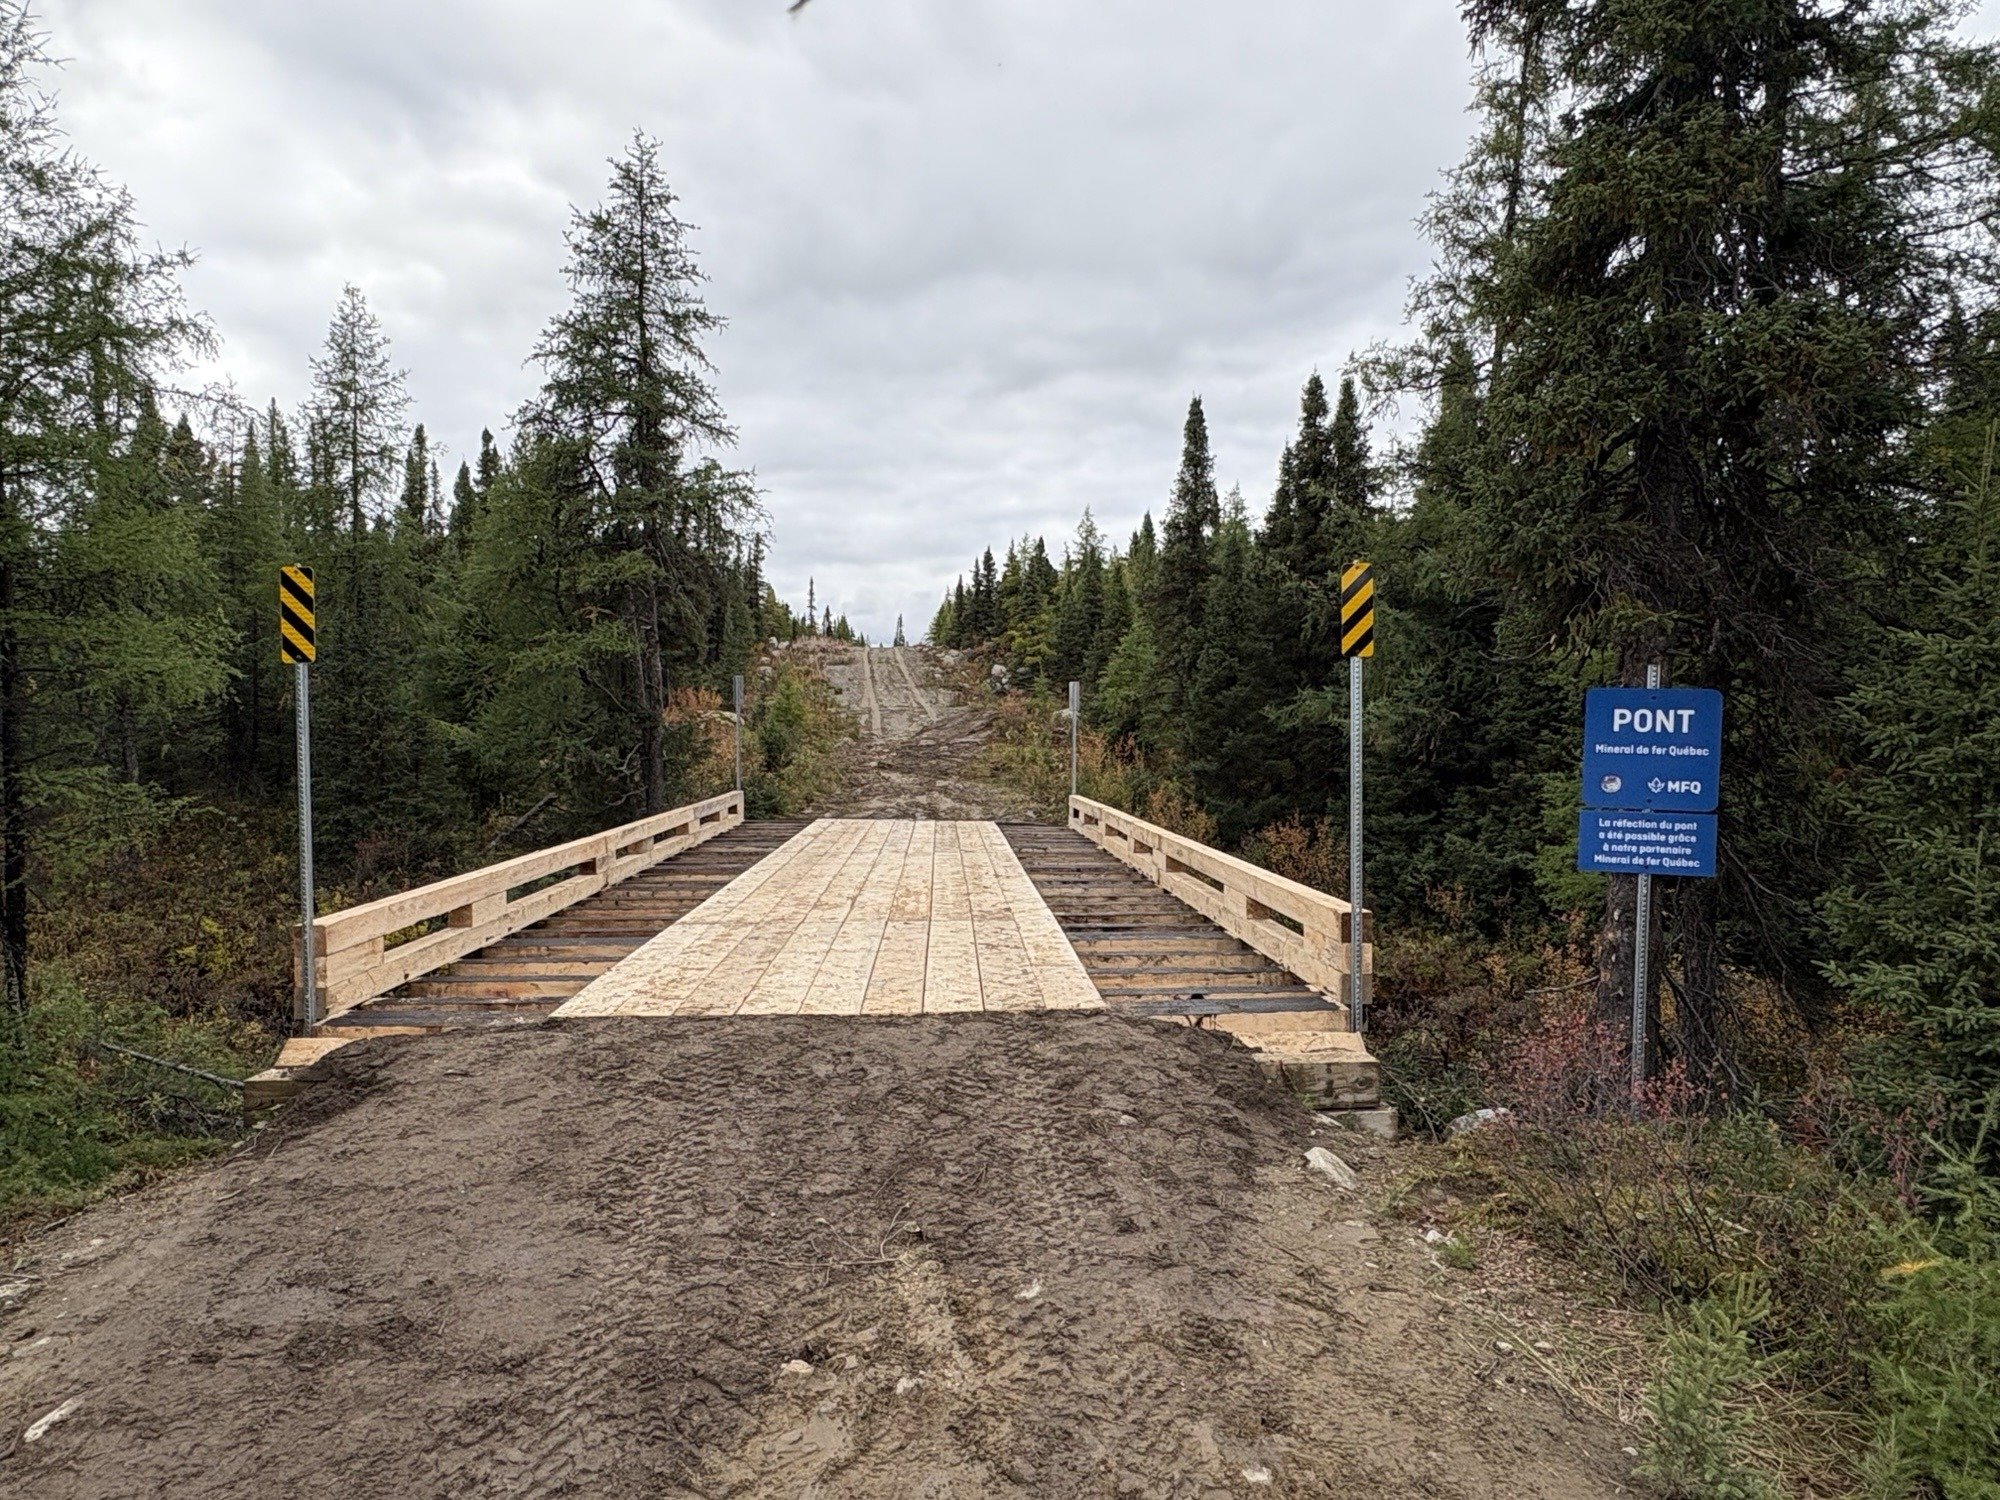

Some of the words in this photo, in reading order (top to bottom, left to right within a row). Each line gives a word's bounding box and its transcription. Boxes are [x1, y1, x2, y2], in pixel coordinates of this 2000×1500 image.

[1613, 708, 1696, 733] PONT
[1636, 745, 1650, 755] de
[1651, 745, 1667, 755] fer
[1669, 745, 1710, 757] Québec
[1667, 780, 1702, 795] MFQ
[1598, 818, 1611, 827] La
[1612, 818, 1658, 829] réfection
[1659, 820, 1672, 830] du
[1674, 822, 1698, 832] pont
[1598, 831, 1606, 839] a
[1606, 829, 1624, 840] été
[1624, 831, 1667, 842] possible
[1668, 833, 1698, 844] grâce
[1602, 842, 1610, 852] à
[1611, 843, 1638, 853] notre
[1639, 844, 1692, 855] partenaire
[1593, 854, 1631, 864] Minerai
[1631, 856, 1645, 866] de
[1646, 856, 1662, 866] fer
[1662, 857, 1701, 868] Québec
